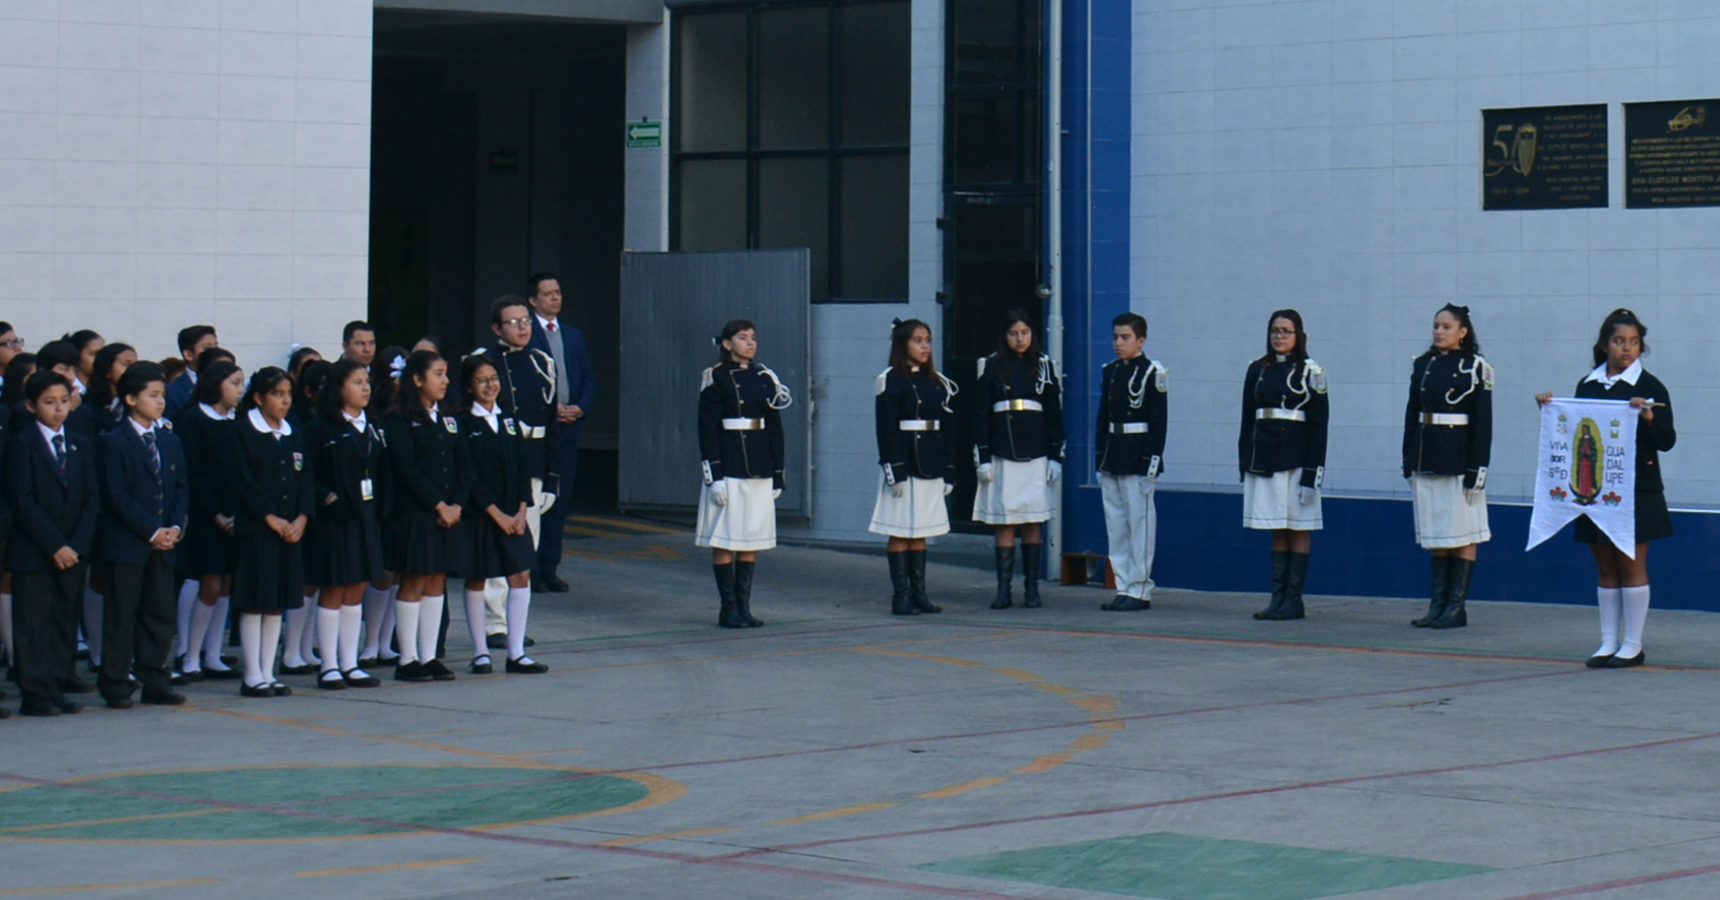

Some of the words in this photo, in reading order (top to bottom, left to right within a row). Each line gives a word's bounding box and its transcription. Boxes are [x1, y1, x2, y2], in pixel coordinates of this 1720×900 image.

[1606, 446, 1625, 457] GUA
[1606, 459, 1624, 470] DAL
[1605, 472, 1624, 486] UPE
